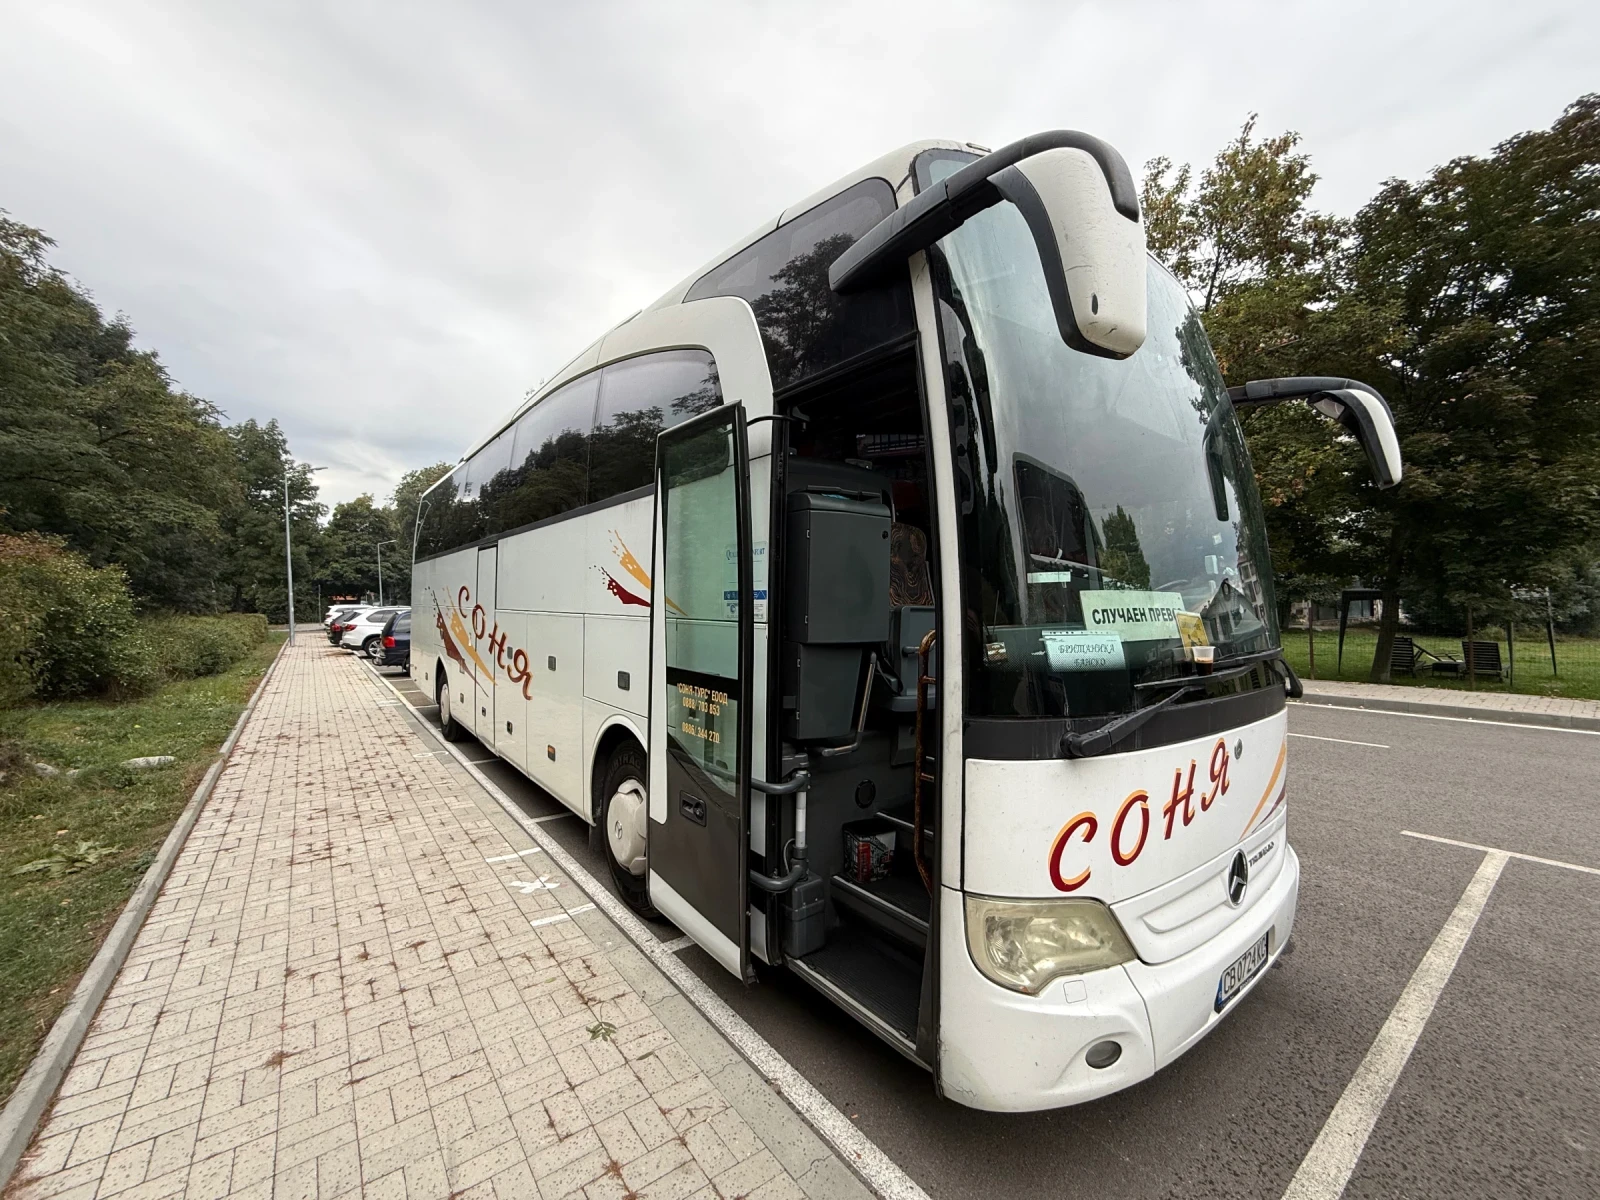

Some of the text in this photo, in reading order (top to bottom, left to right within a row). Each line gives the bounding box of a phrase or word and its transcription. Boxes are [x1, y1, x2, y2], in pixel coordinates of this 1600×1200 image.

[458, 585, 533, 700] СОНЯ
[1092, 608, 1148, 625] СЛУЧАЕН
[711, 690, 728, 706] ЕООД
[1047, 737, 1230, 892] СОНЯ
